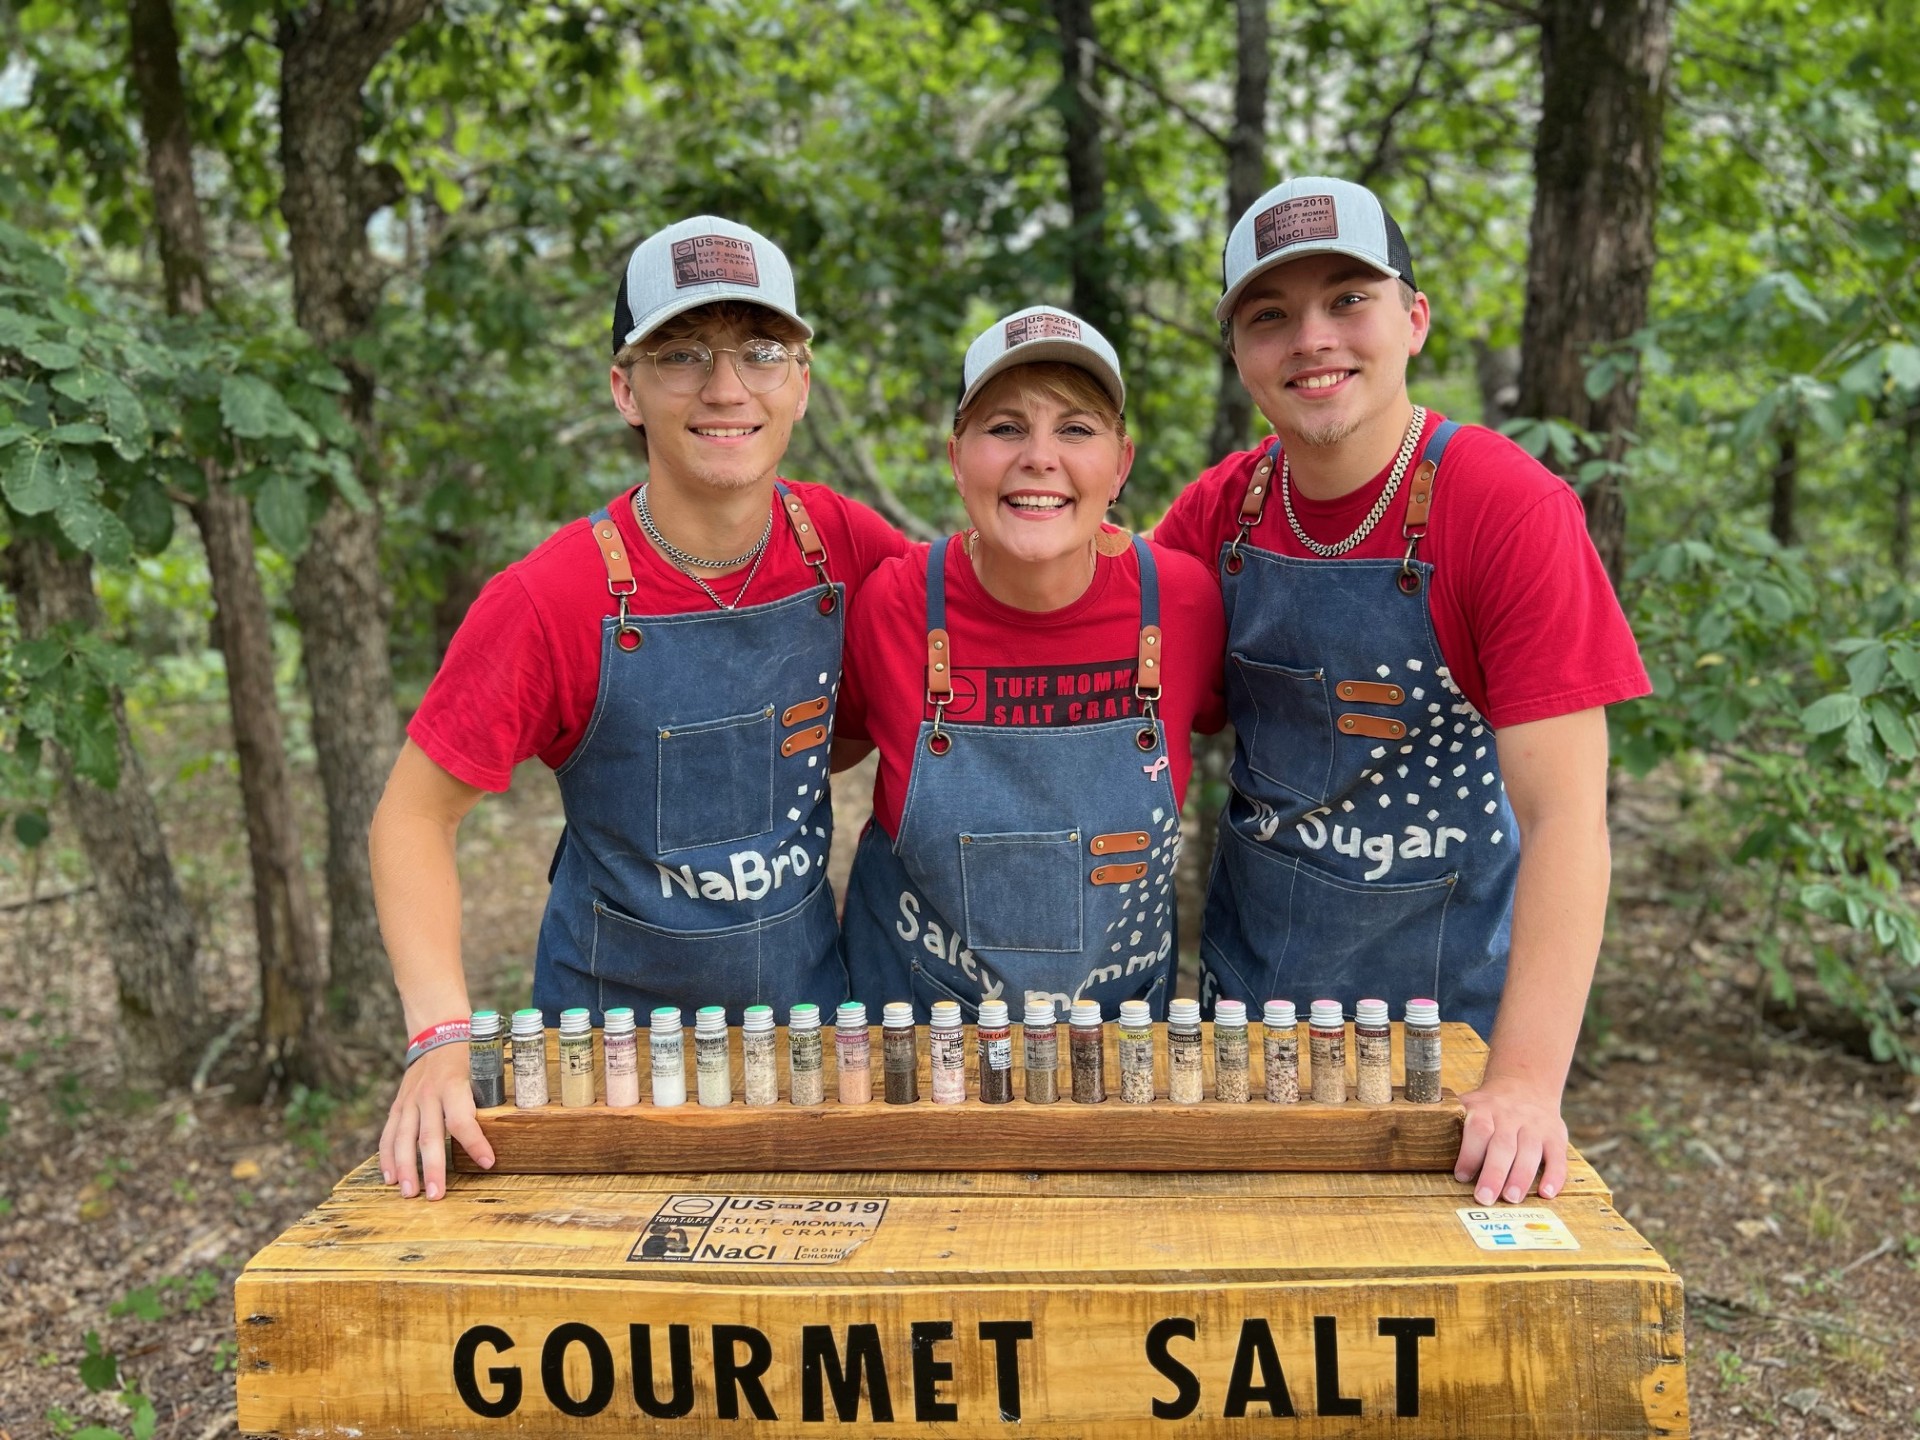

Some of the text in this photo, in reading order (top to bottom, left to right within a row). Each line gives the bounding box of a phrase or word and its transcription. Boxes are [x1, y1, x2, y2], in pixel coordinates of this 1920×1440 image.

[1276, 203, 1291, 215] US
[1303, 198, 1330, 207] 2019
[1277, 220, 1296, 231] SALT
[1278, 228, 1303, 243] NaCl
[696, 238, 713, 247] US
[725, 240, 750, 252] 2019
[724, 253, 750, 261] MOMMA
[701, 267, 727, 278] NaCl
[1054, 317, 1077, 329] 2019
[994, 668, 1137, 697] TUFF MOMM
[994, 705, 1054, 725] SALT
[1296, 807, 1467, 880] Sugar
[654, 845, 810, 901] NaBro
[896, 891, 1004, 1001] Salty
[1024, 931, 1171, 1011] mmma
[729, 1199, 775, 1211] US
[805, 1200, 880, 1213] 2019
[1492, 1211, 1545, 1220] Square
[713, 1226, 770, 1235] SALT
[792, 1220, 866, 1228] MOMMA
[1480, 1223, 1511, 1231] VISA
[700, 1243, 777, 1260] NaCl
[453, 1315, 1436, 1424] GOURMET SALT
